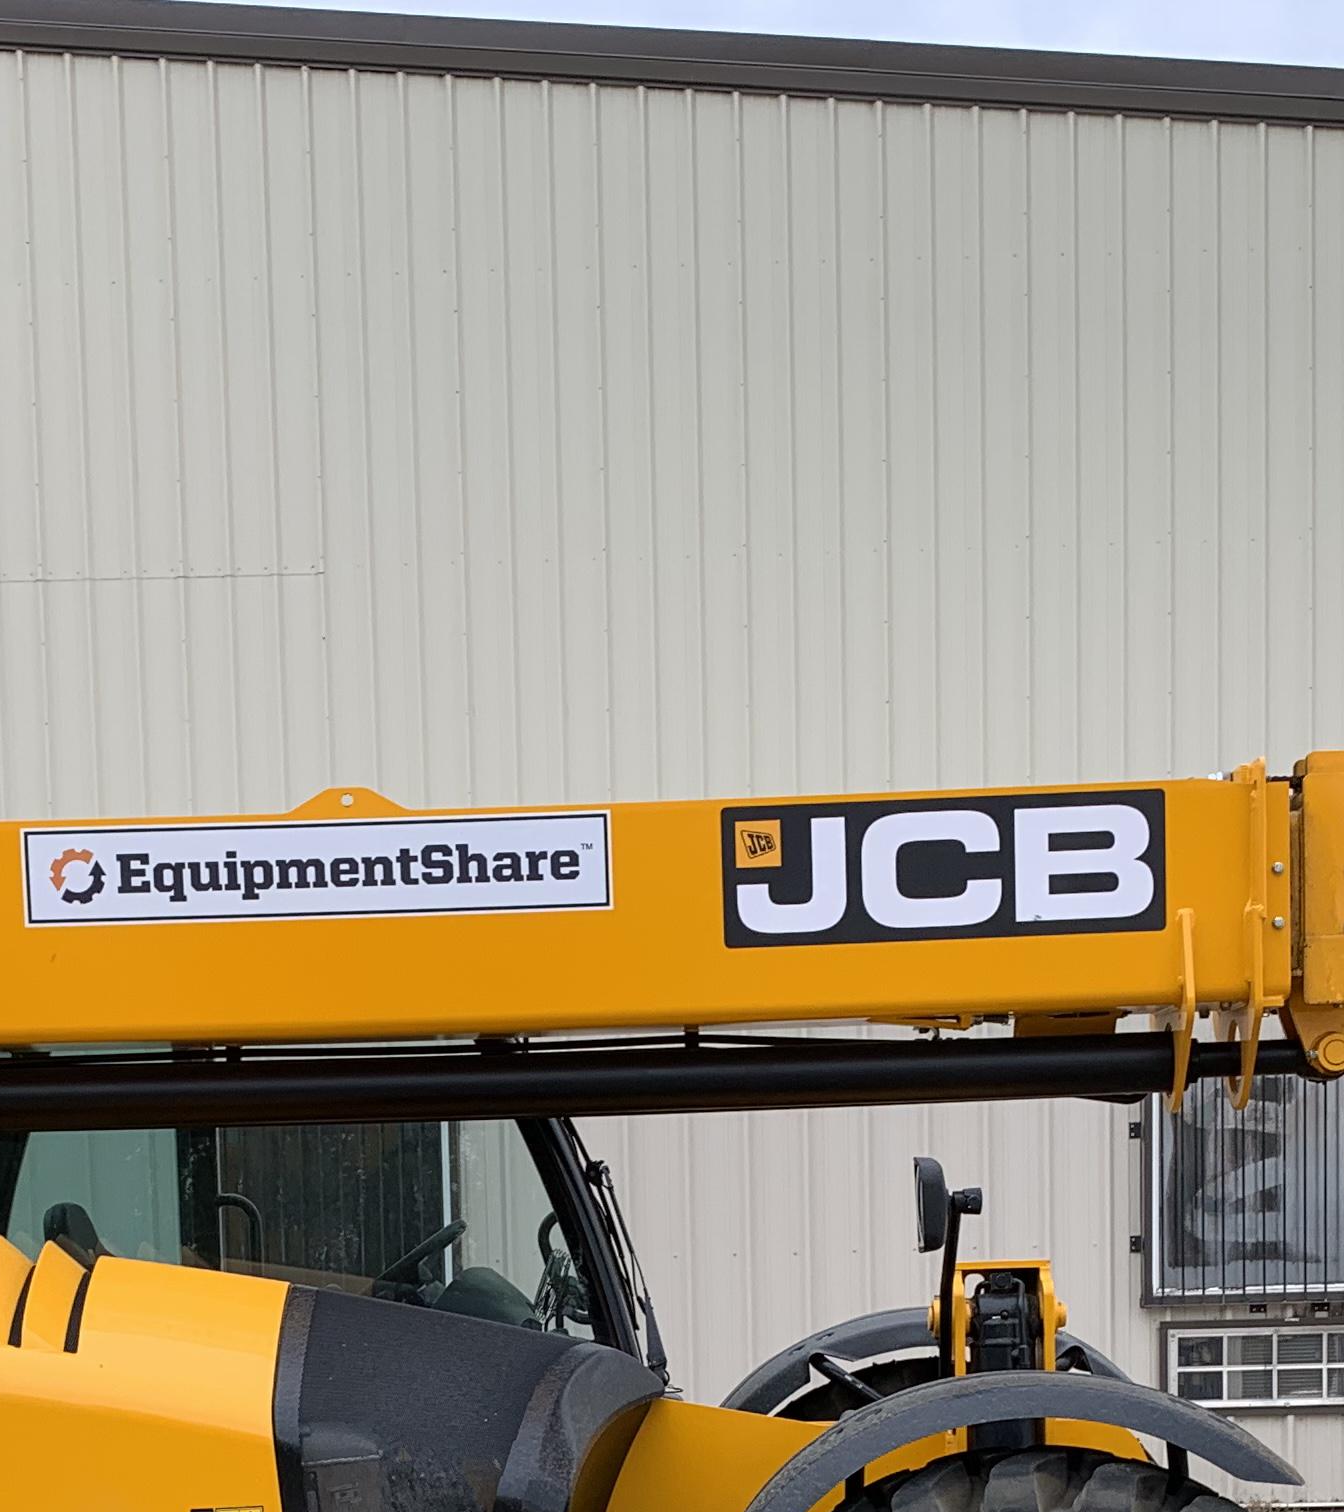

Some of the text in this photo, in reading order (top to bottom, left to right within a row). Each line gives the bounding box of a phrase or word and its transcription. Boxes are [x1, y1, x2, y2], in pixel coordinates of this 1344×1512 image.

[115, 843, 581, 903] EquipmentShare
[736, 804, 1155, 934] JCB
[746, 832, 774, 856] JCB
